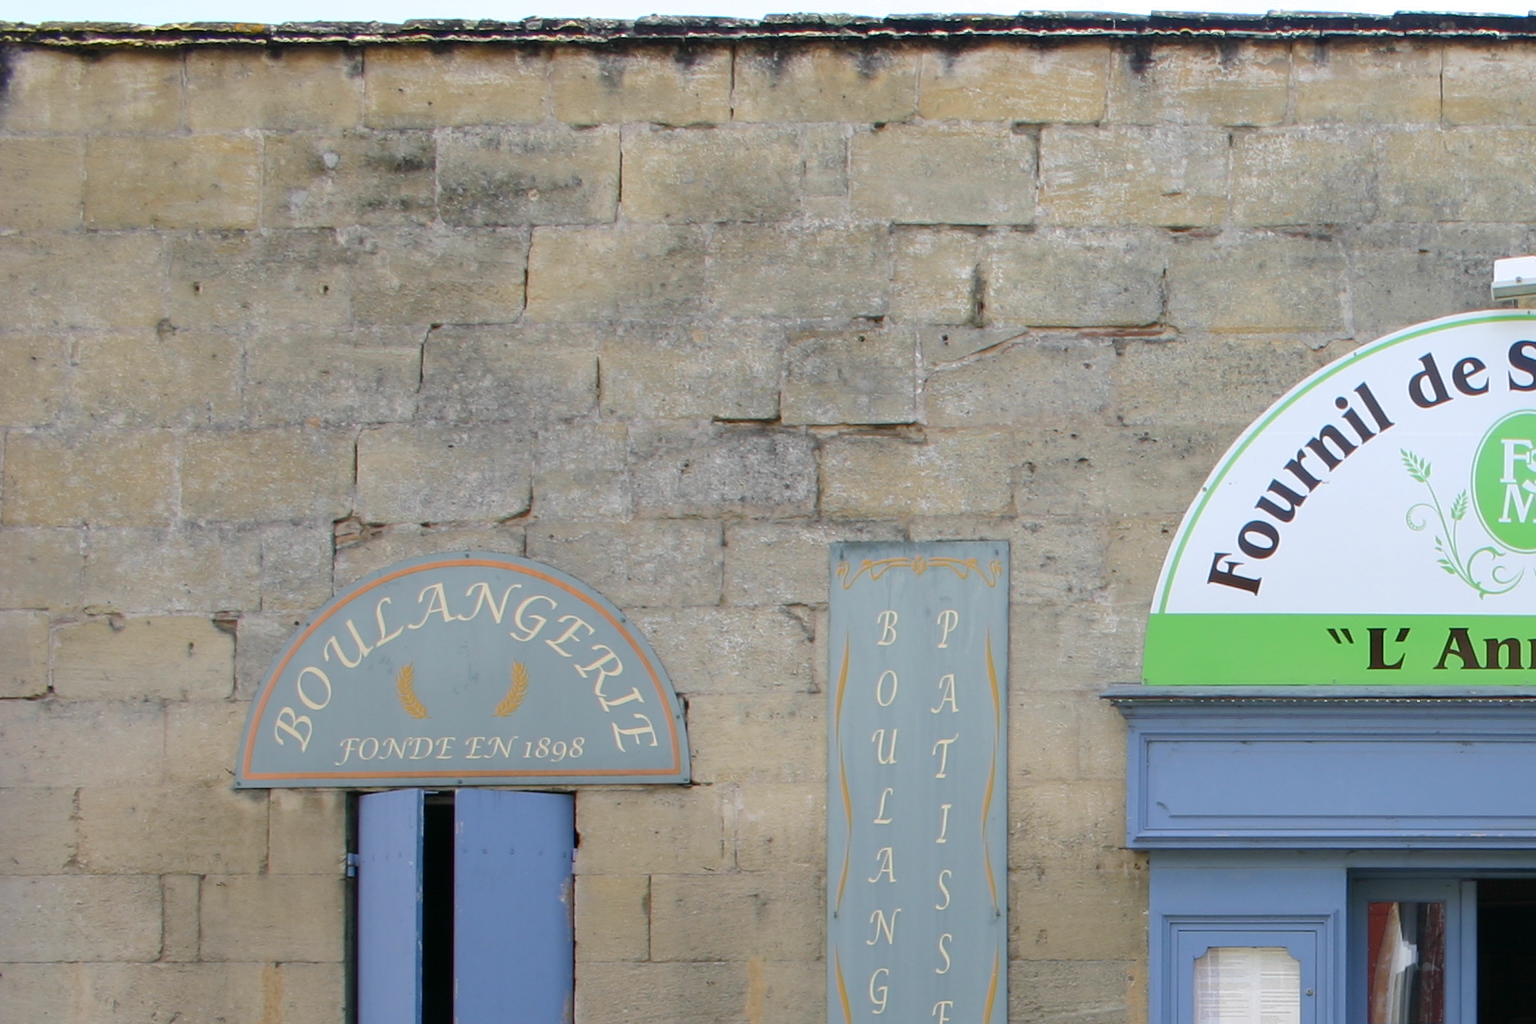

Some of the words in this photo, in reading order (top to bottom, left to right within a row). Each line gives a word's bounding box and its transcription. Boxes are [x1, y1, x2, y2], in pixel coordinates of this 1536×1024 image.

[1206, 382, 1395, 596] Fournil
[1407, 352, 1490, 408] de
[274, 582, 658, 753] BOULANGERIE
[335, 736, 456, 766] FONDE
[465, 735, 518, 760] EN
[522, 736, 585, 763] 1898
